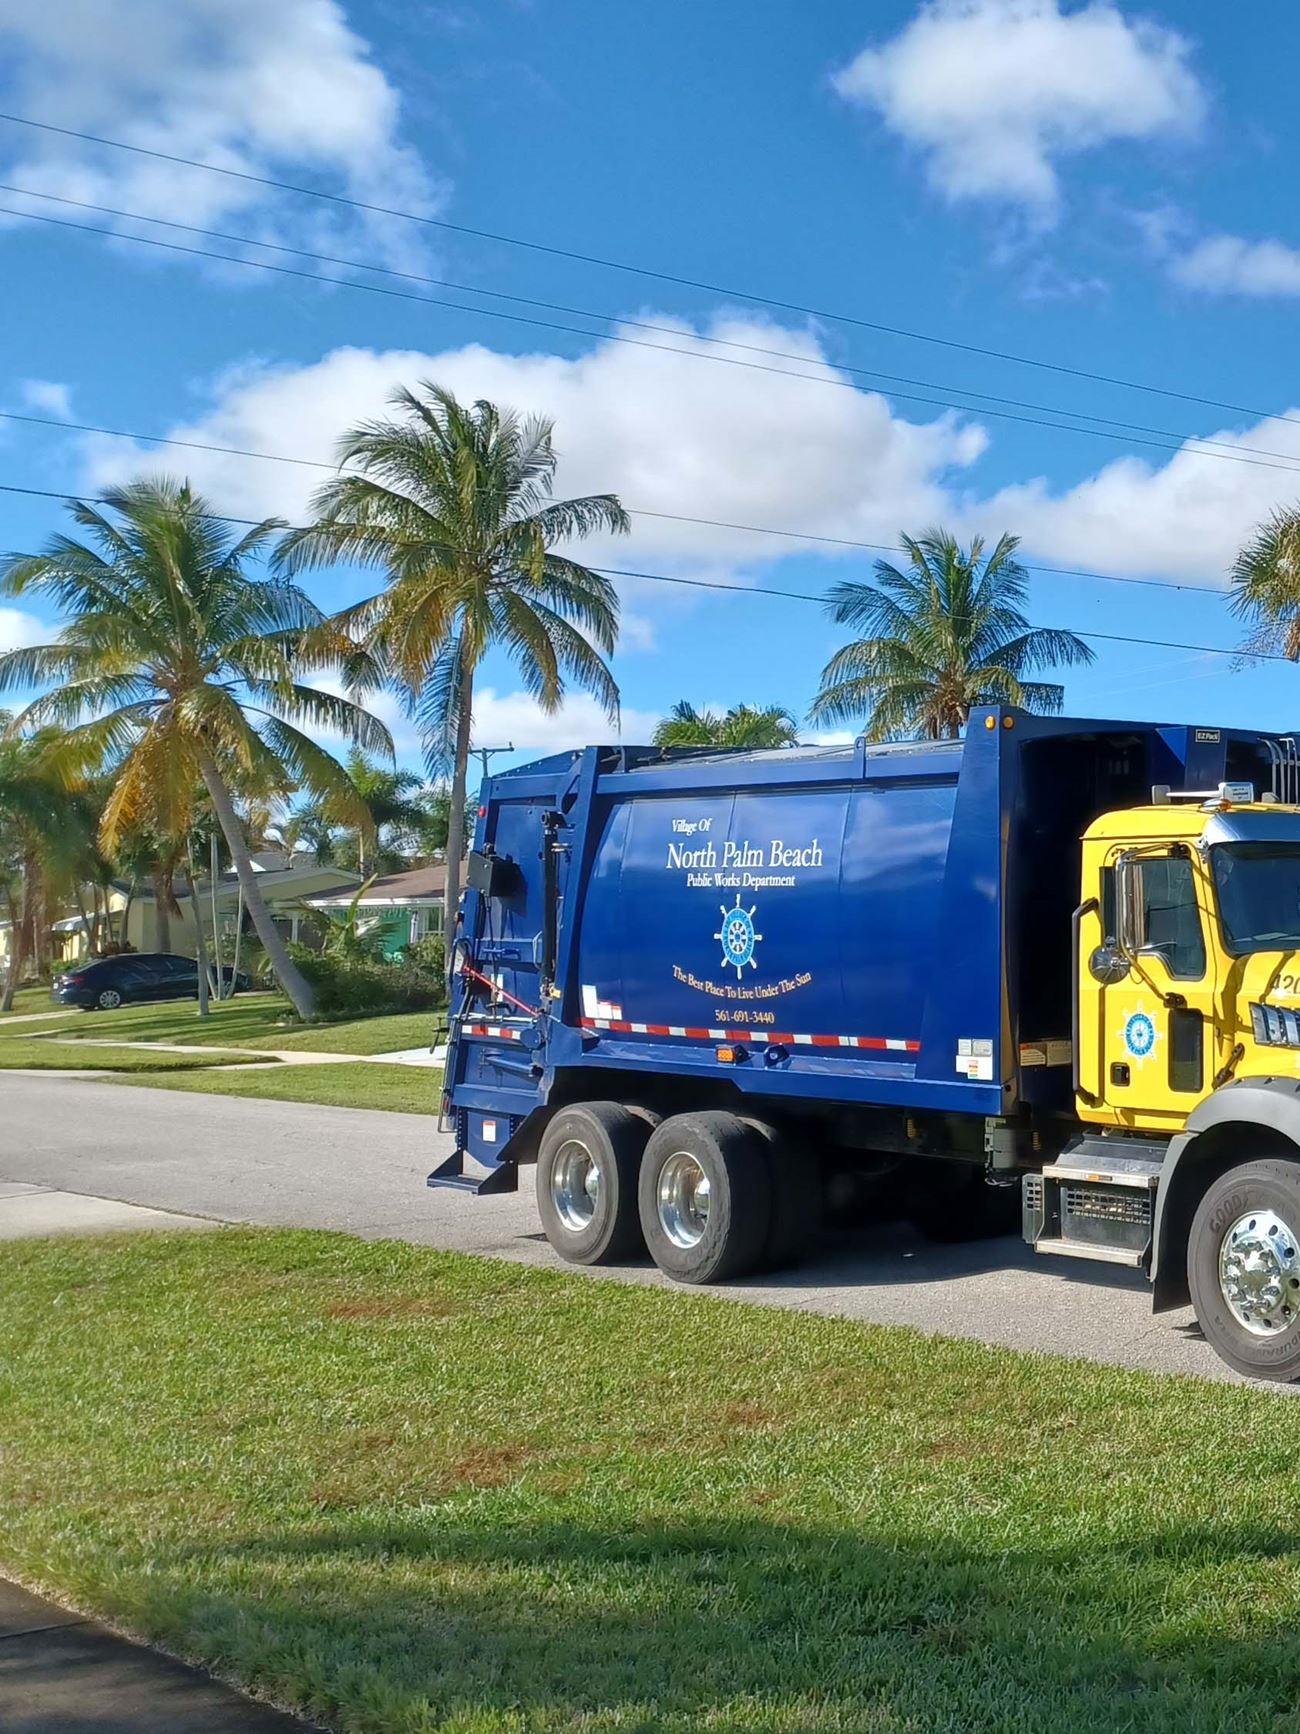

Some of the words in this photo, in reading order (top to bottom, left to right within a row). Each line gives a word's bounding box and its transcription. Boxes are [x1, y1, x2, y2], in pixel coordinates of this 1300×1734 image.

[672, 819, 697, 836] Village
[699, 818, 712, 832] Of
[666, 841, 716, 868] North
[721, 840, 764, 868] Palm
[768, 838, 823, 867] Beach
[687, 873, 712, 887] Public
[714, 873, 740, 887] Works
[742, 872, 795, 891] Department
[672, 965, 687, 982] The
[688, 973, 704, 991] Best
[705, 981, 725, 997] Place
[725, 986, 736, 998] To
[738, 987, 754, 999] Live
[755, 984, 779, 998] Under
[779, 980, 795, 993] The
[795, 972, 812, 986] Sun
[715, 1009, 775, 1024] 561-691-3440
